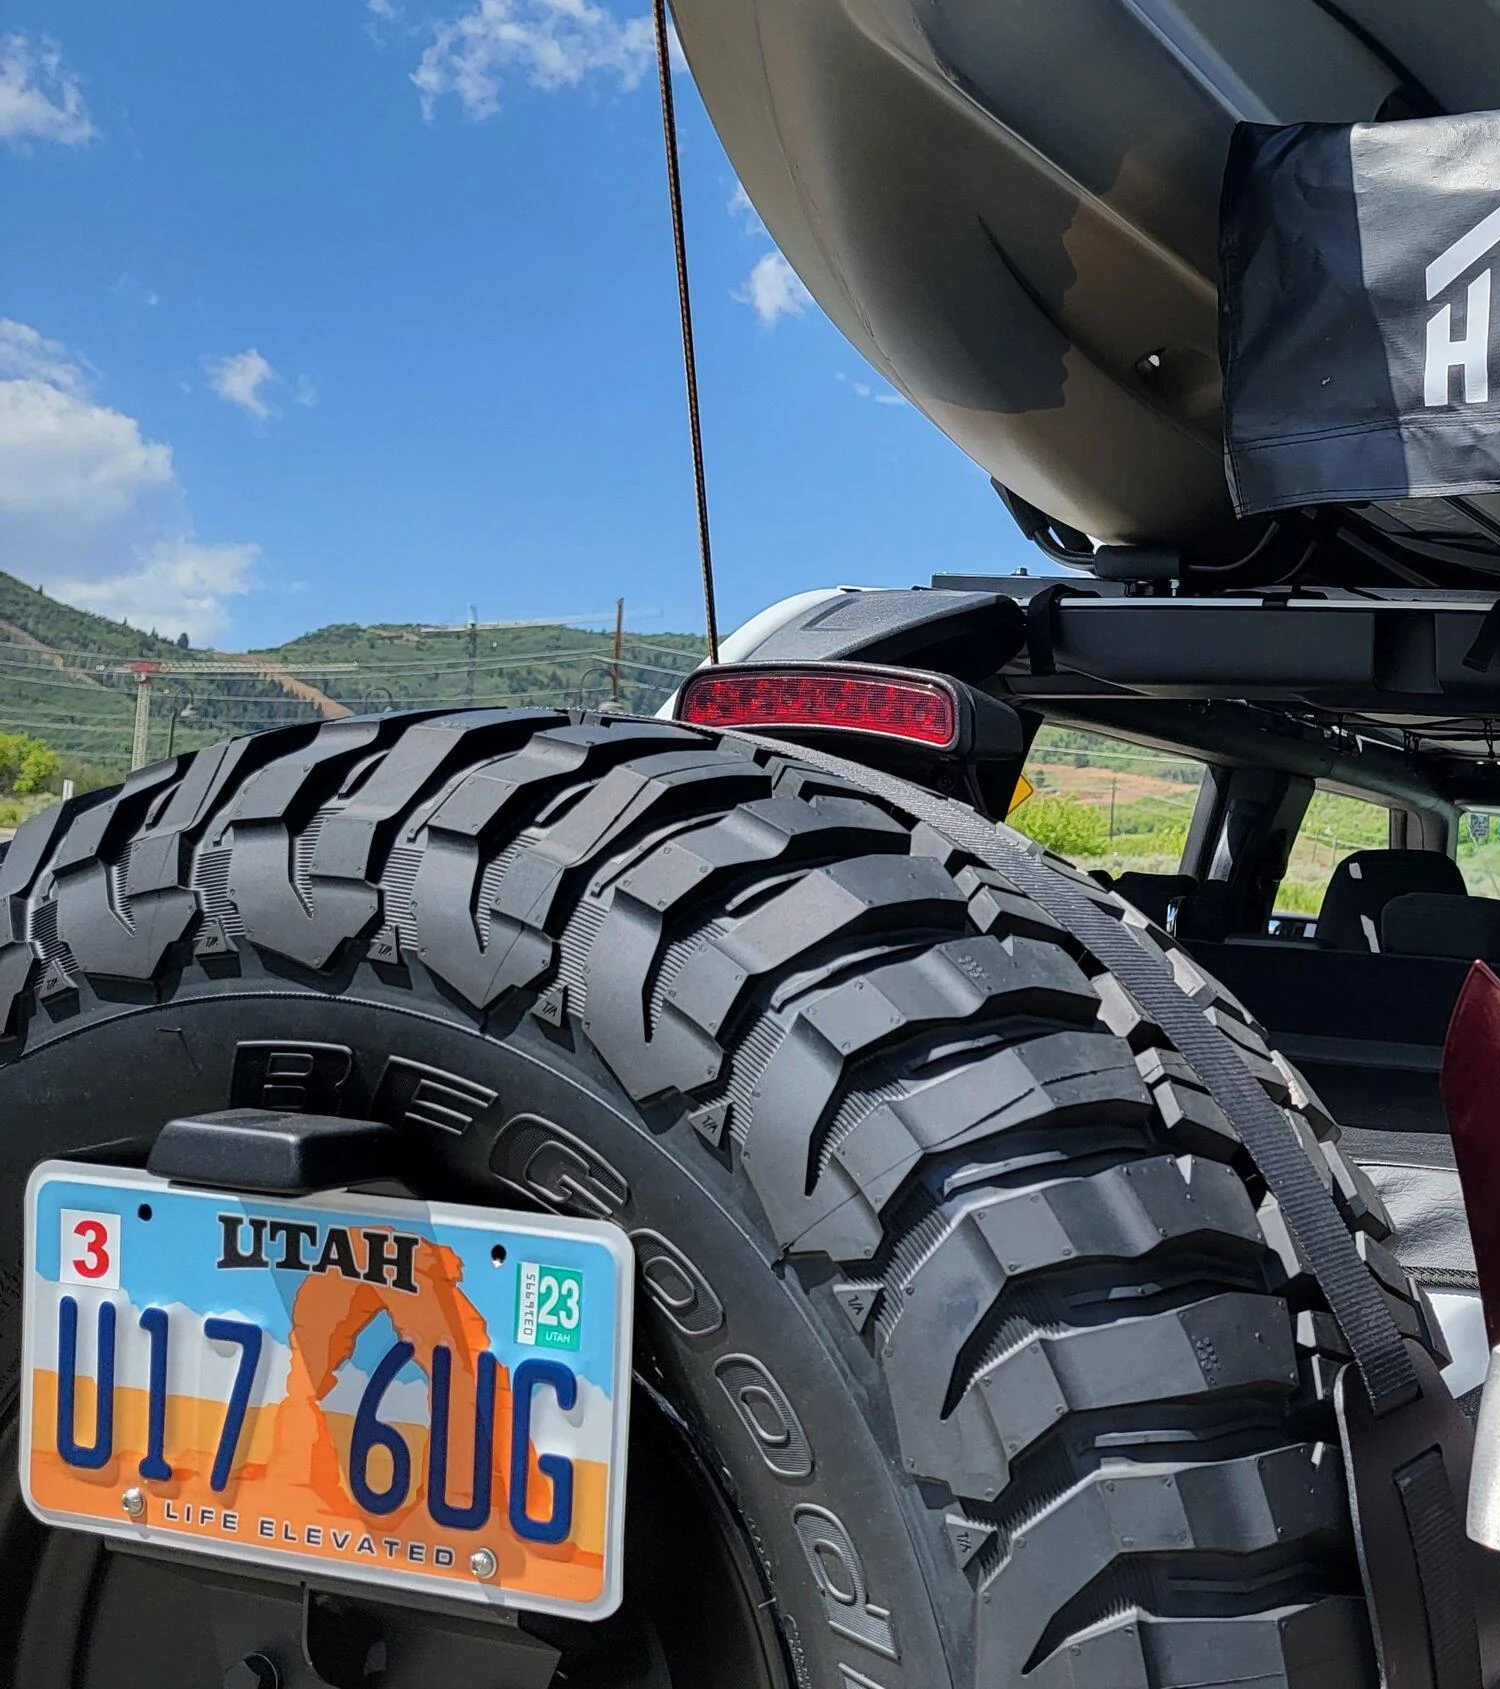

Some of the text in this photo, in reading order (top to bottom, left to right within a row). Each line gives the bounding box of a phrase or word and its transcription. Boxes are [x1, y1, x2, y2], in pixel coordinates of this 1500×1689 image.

[72, 1219, 111, 1279] 3
[216, 1213, 422, 1294] UTAH
[537, 1275, 580, 1330] 23
[545, 1331, 571, 1344] UTAH
[56, 1295, 578, 1545] U17 6UG
[164, 1501, 455, 1568] LIFE ELEVATED
